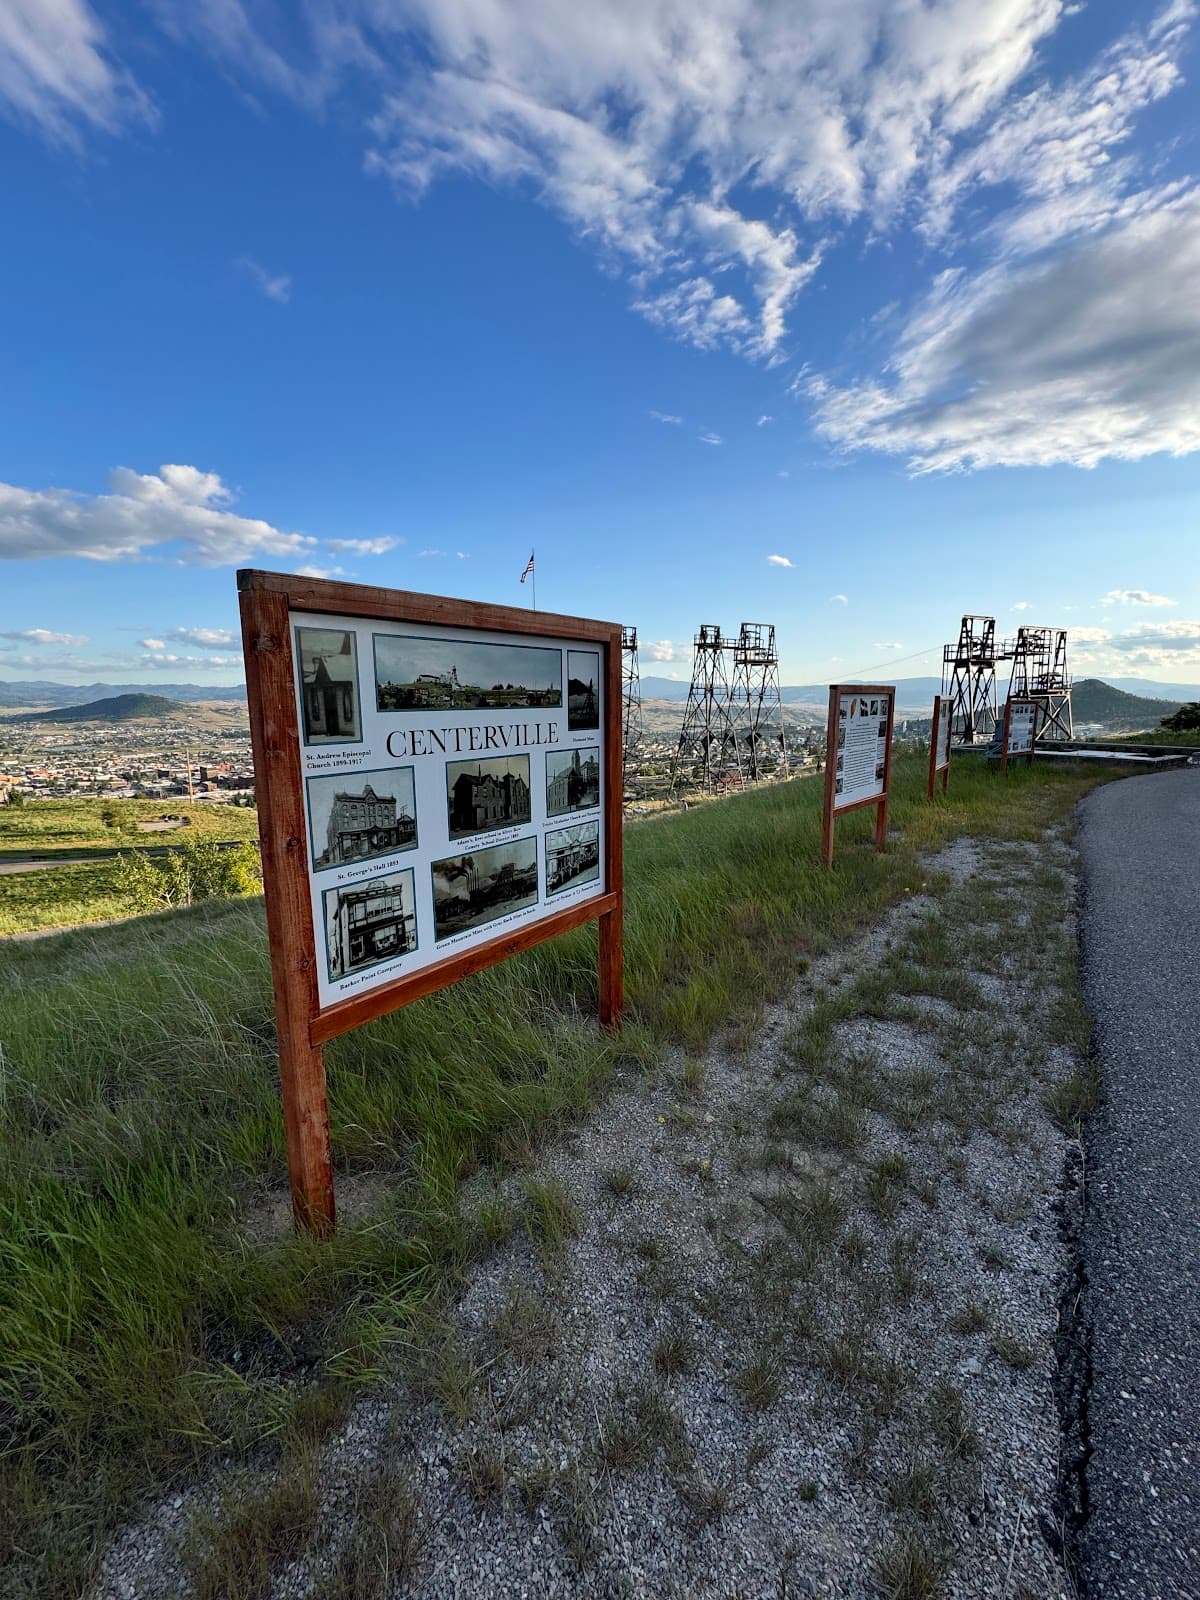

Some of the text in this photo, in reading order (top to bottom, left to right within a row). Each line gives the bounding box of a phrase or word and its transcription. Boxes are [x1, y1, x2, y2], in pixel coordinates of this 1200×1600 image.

[386, 722, 559, 758] CENTERVILLE
[342, 750, 371, 758] Episcopal
[347, 866, 373, 877] George's
[376, 963, 402, 976] Company
